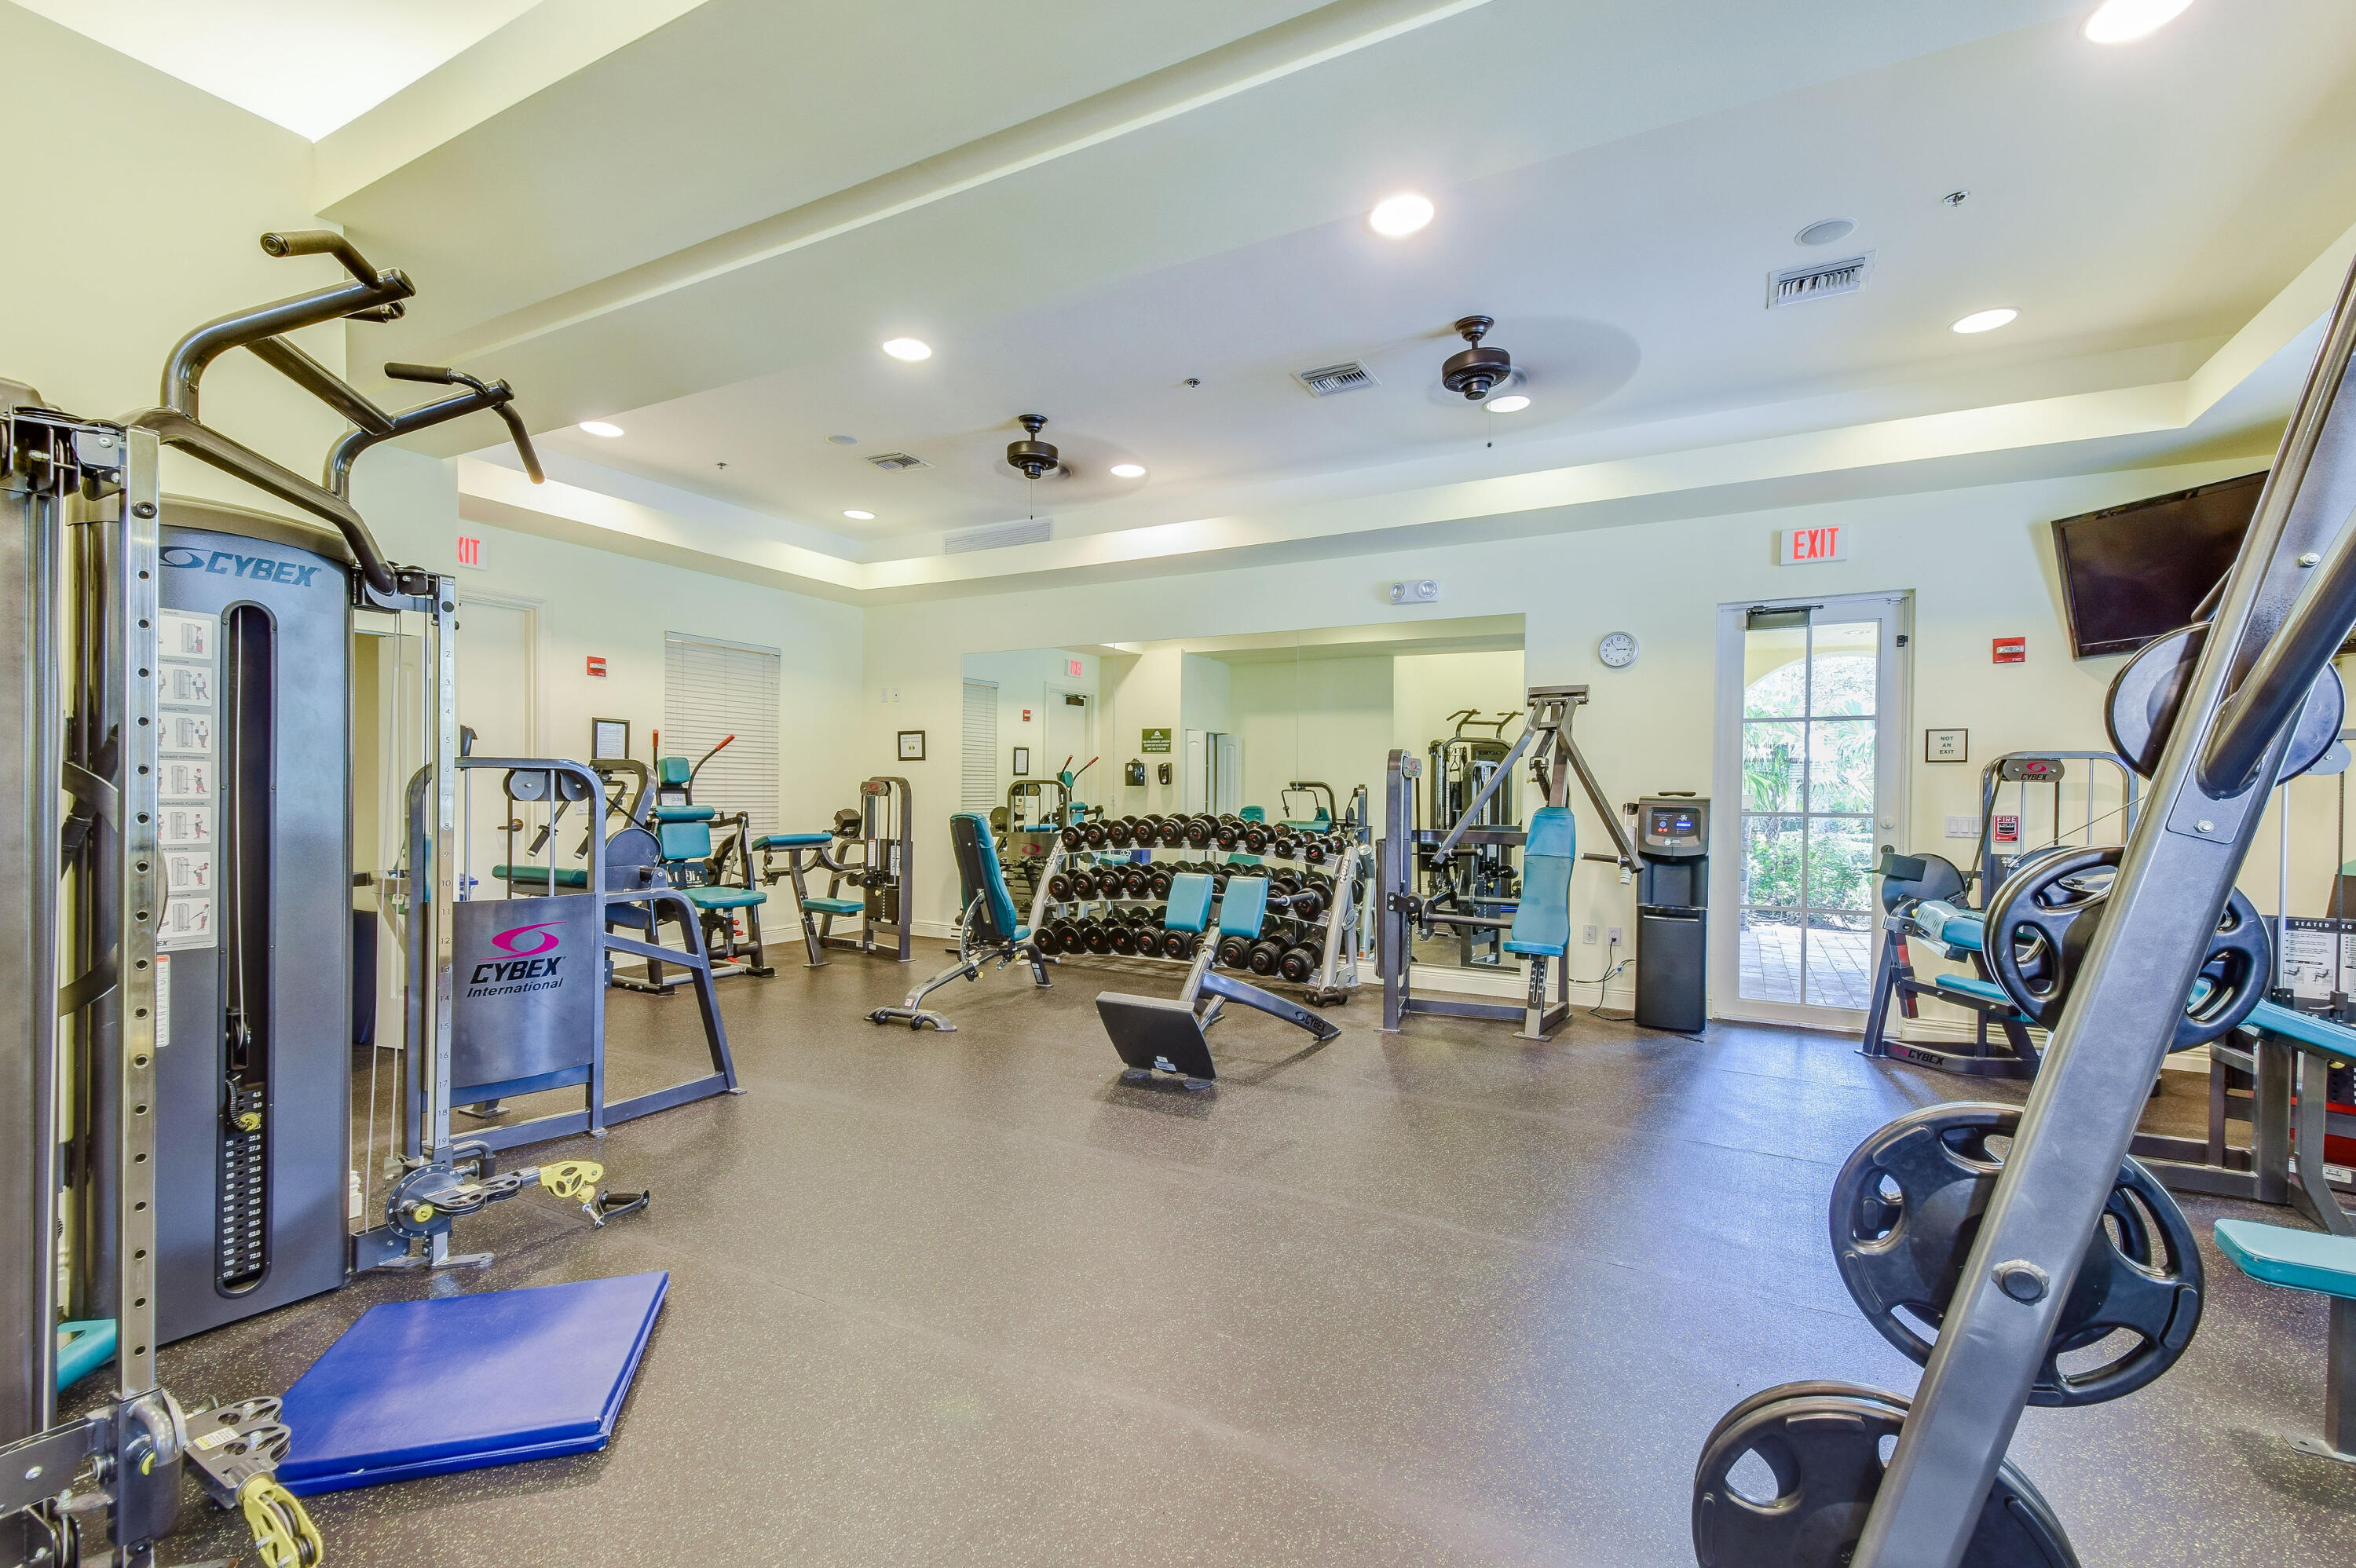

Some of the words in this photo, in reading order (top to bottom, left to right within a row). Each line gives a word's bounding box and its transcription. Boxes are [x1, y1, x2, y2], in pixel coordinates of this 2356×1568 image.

[459, 536, 480, 565] XIT
[1793, 527, 1839, 559] EXIT
[205, 550, 318, 587] CYBEX
[470, 956, 563, 985] CYBEX
[466, 978, 564, 998] International
[1908, 1049, 1945, 1065] CYBEX
[439, 1080, 448, 1088] 17
[438, 1137, 447, 1146] 19
